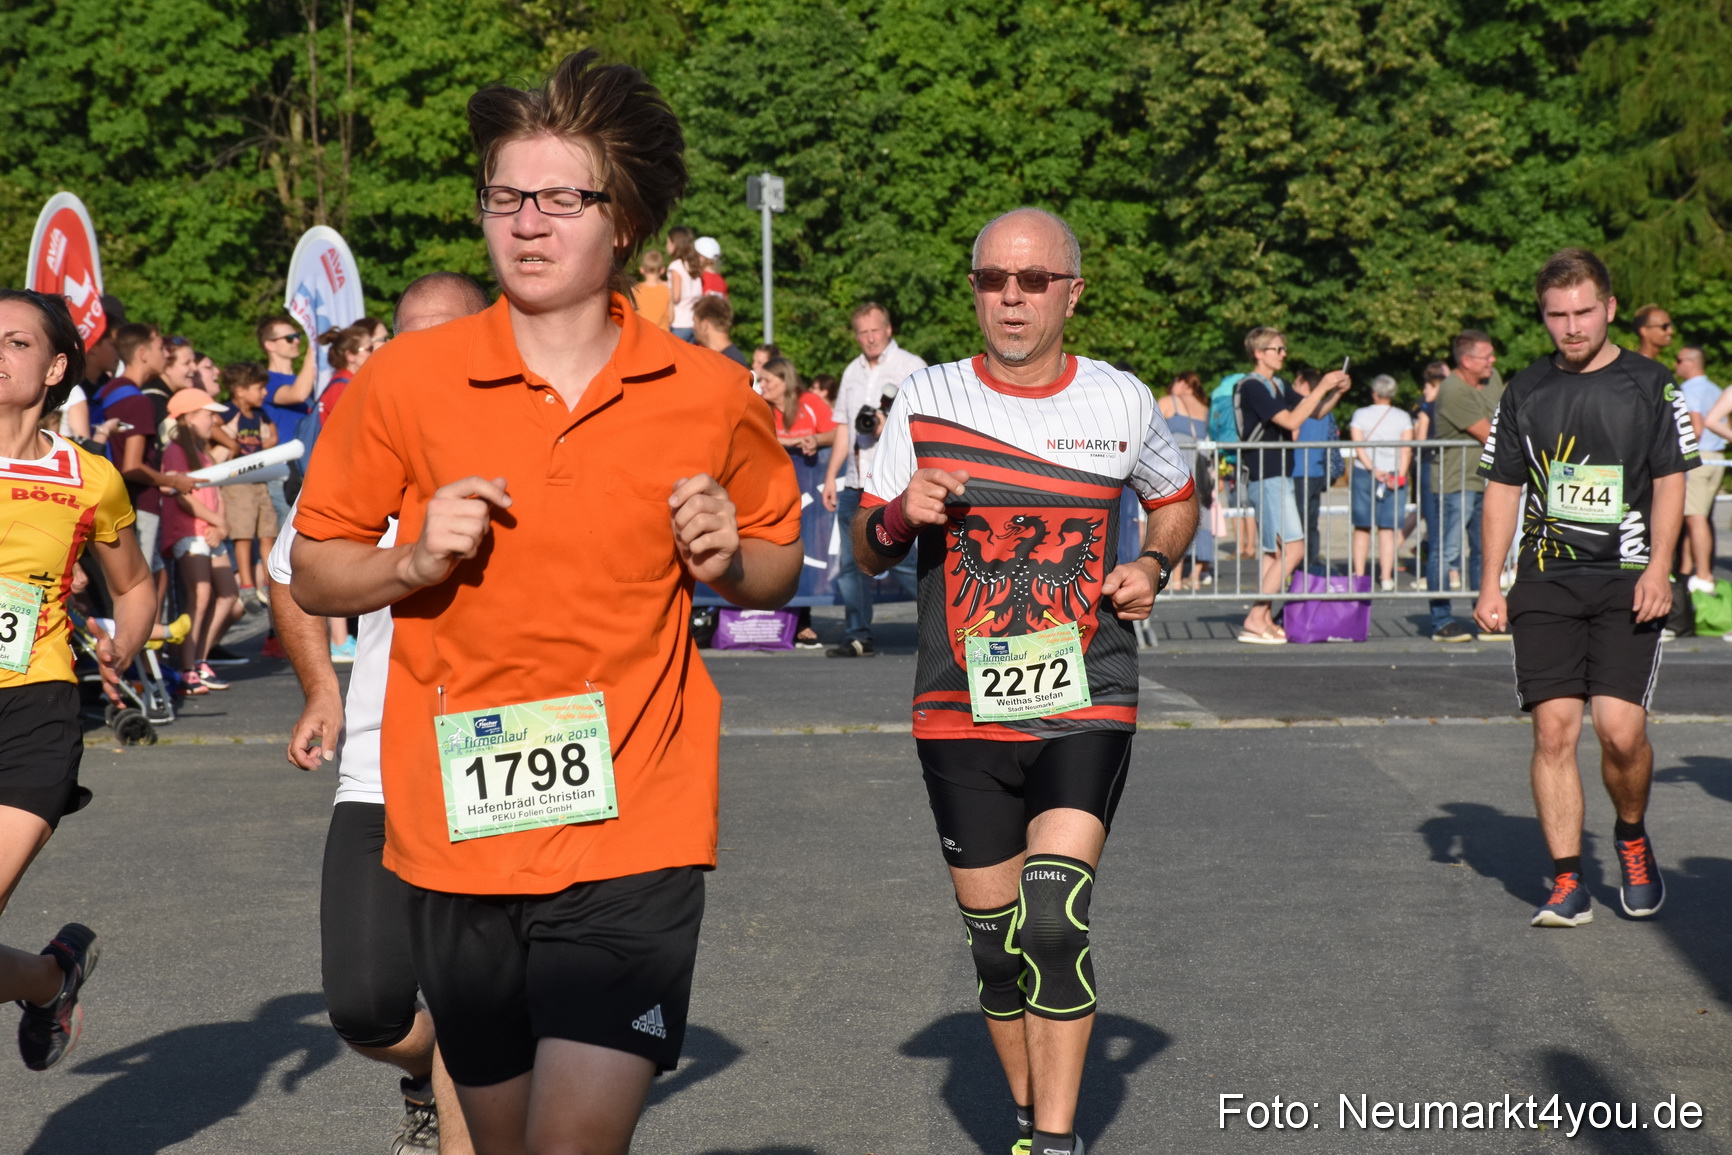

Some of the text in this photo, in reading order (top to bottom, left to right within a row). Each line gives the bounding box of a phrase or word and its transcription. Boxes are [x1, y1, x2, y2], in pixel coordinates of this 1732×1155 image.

[1047, 439, 1117, 451] NEUMARKT
[11, 486, 80, 510] BÖGL
[1557, 483, 1611, 506] 1744
[10, 605, 31, 616] 2019
[0, 612, 18, 643] 3
[983, 651, 1028, 663] firmenlauf
[1055, 646, 1074, 657] 2019
[982, 658, 1071, 697] 2272
[996, 691, 1063, 706] Weithas Stefan
[1025, 702, 1054, 711] Neumarkt
[465, 728, 527, 749] firmenlauf
[568, 728, 597, 741] 2019
[465, 743, 590, 800] 1798
[467, 789, 596, 816] Hafenbrädl Christian
[492, 804, 572, 822] PEKU Folien GmbH
[1025, 870, 1067, 882] UliMit
[631, 1019, 667, 1039] adidas
